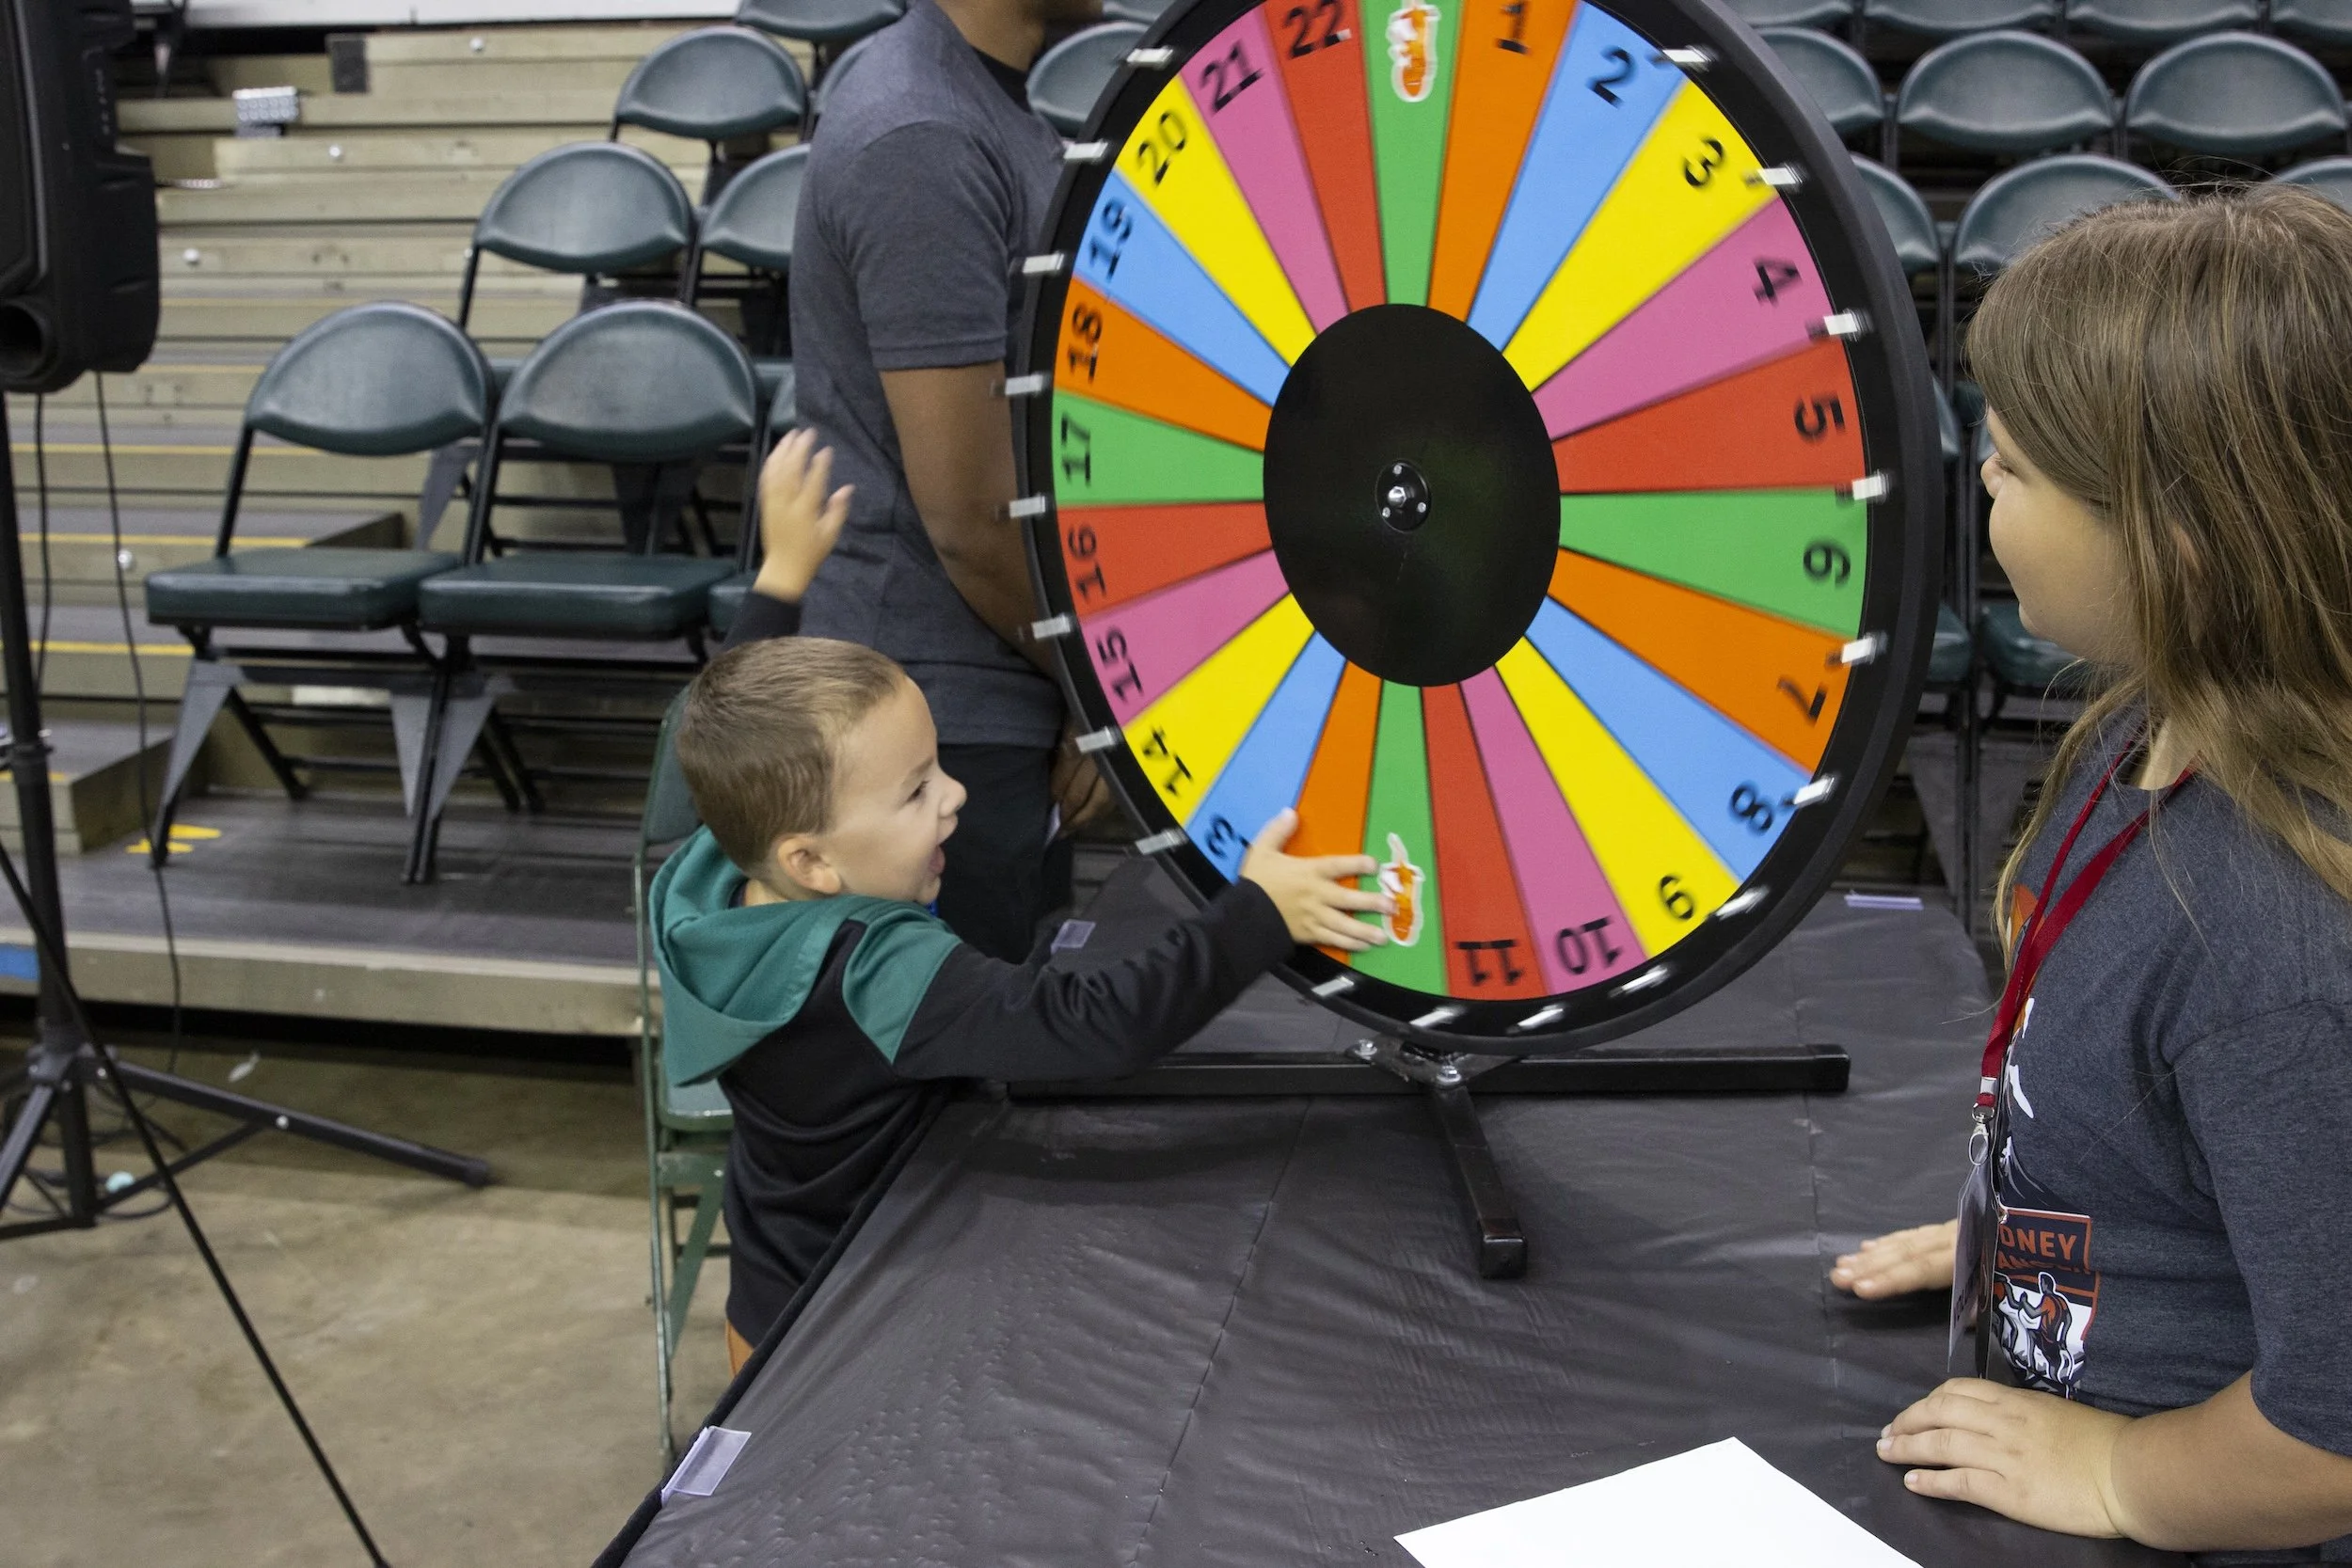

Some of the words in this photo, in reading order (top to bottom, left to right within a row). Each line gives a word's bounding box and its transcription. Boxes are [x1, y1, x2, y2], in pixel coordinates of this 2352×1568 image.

[1283, 0, 1345, 59] 22
[1495, 0, 1532, 55] 1
[1199, 39, 1263, 114] 21
[1587, 45, 1637, 108] 2
[1136, 108, 1189, 187] 20
[1682, 136, 1725, 190] 3
[1089, 198, 1134, 281] 19
[1754, 257, 1802, 305] 4
[1068, 303, 1104, 383] 18
[1794, 392, 1846, 442] 5
[1059, 412, 1092, 487] 17
[1067, 522, 1108, 600] 16
[1803, 539, 1852, 587] 6
[1097, 626, 1144, 704] 15
[1776, 673, 1828, 726] 7
[1142, 724, 1194, 798] 14
[1728, 782, 1774, 836] 8
[1657, 874, 1697, 922] 9
[1455, 939, 1524, 988] 11
[1555, 916, 1626, 975] 10
